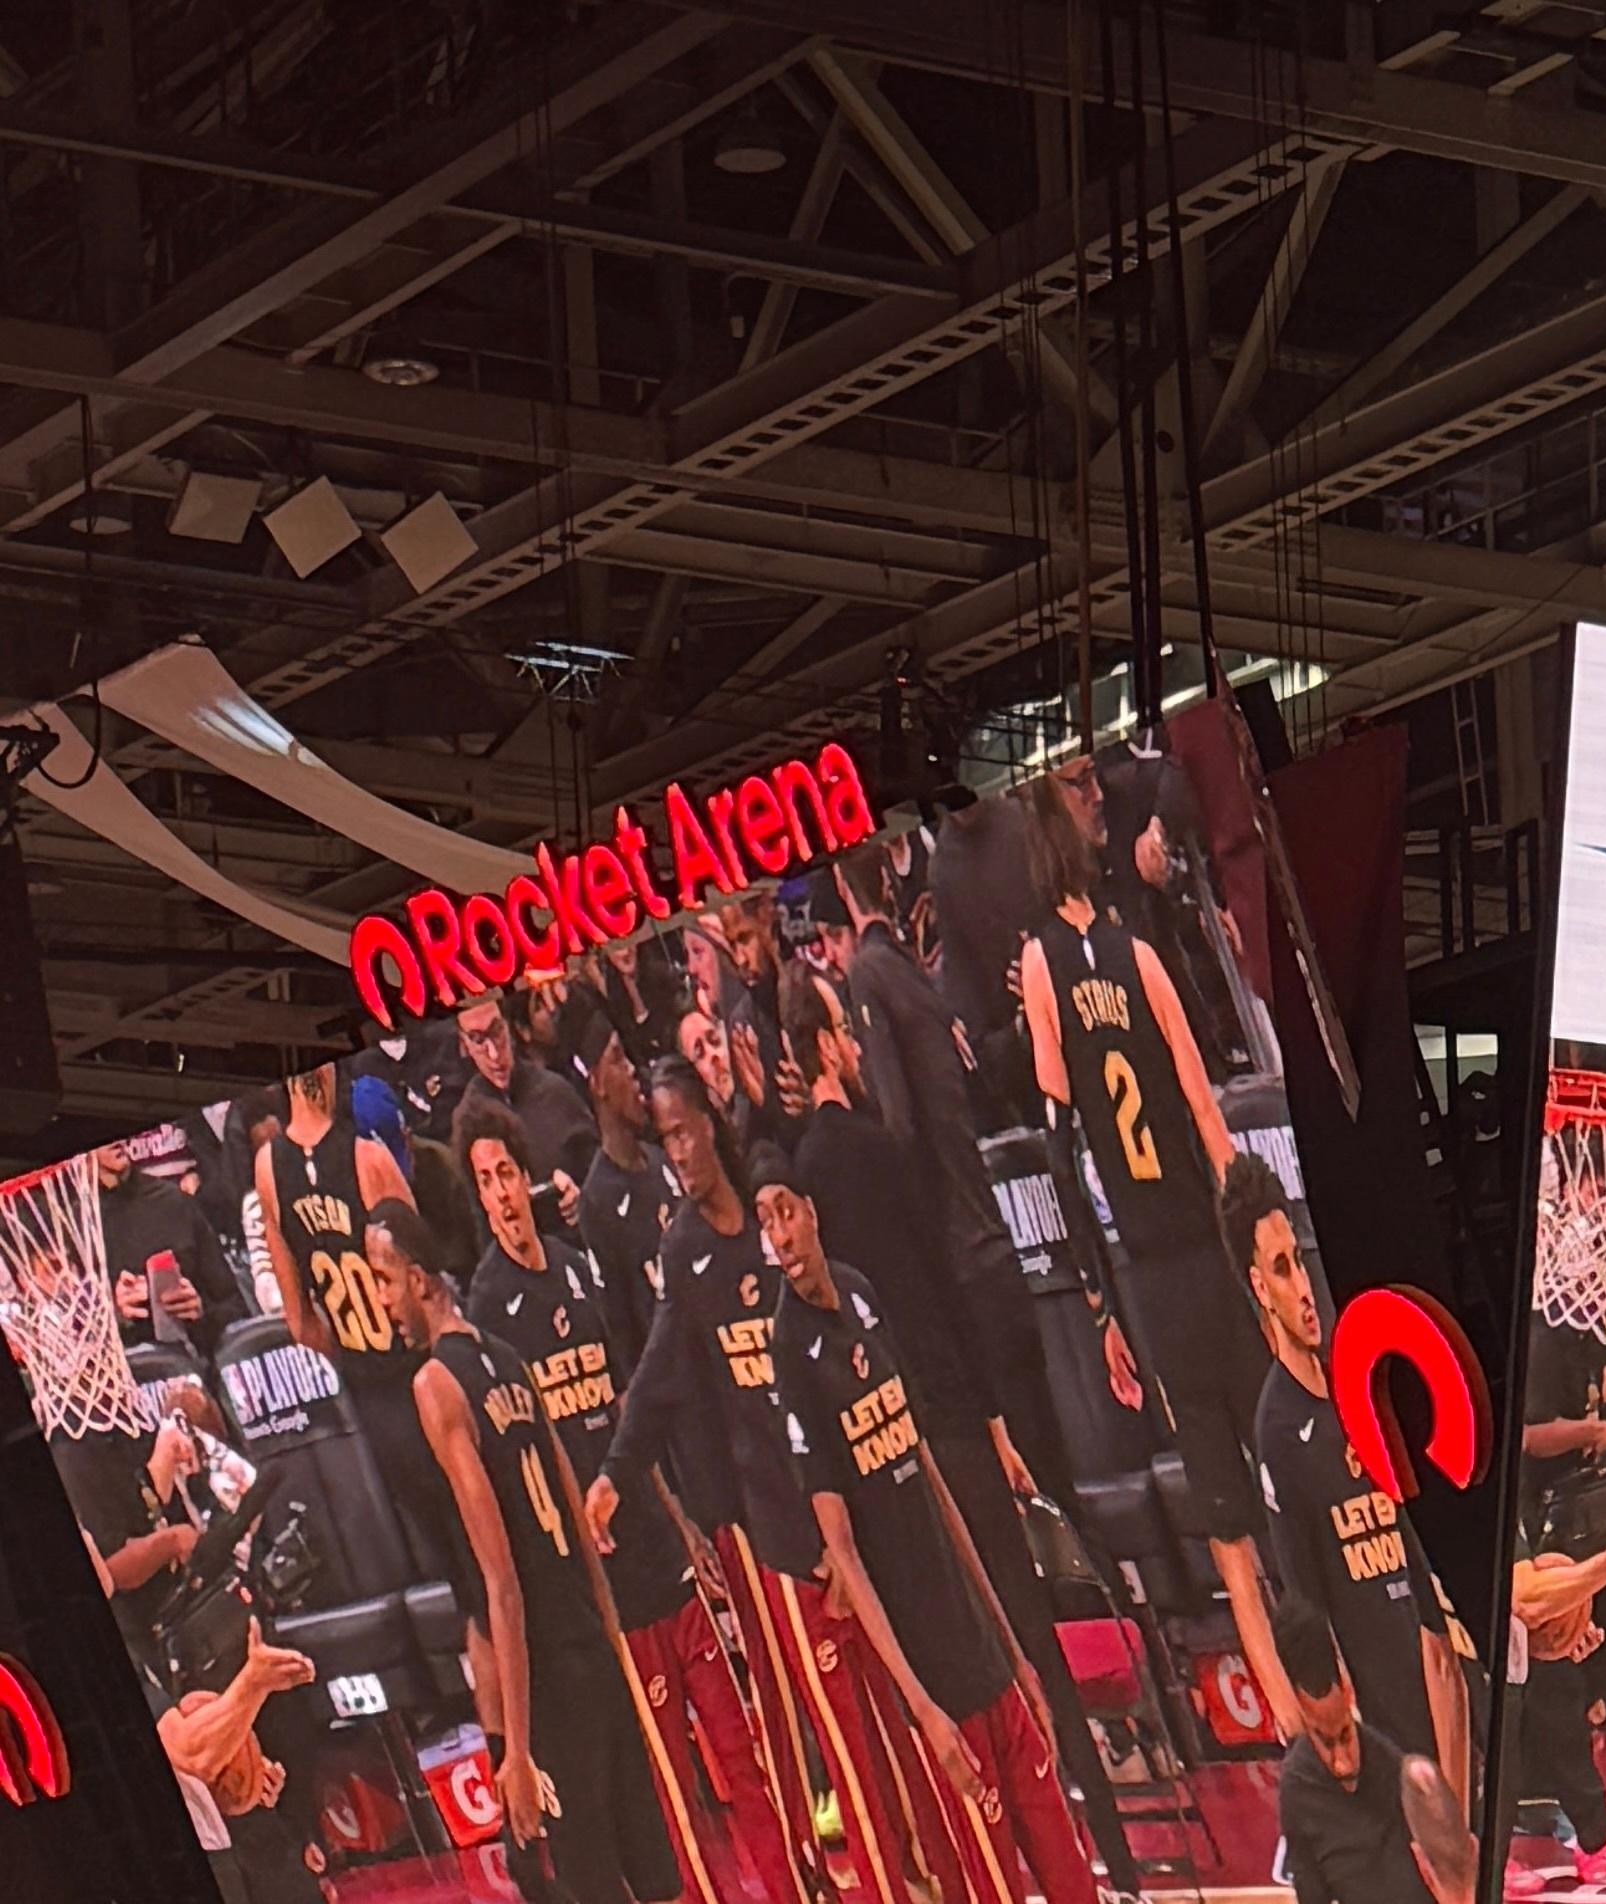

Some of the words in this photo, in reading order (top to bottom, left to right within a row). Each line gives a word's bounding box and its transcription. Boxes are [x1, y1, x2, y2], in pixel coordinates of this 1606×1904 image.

[407, 806, 671, 1007] Rocket
[666, 742, 876, 910] Arena
[1103, 1051, 1162, 1180] 2
[310, 1251, 392, 1353] 20
[242, 1344, 341, 1425] PLAYOFFS
[520, 1448, 569, 1557] 4
